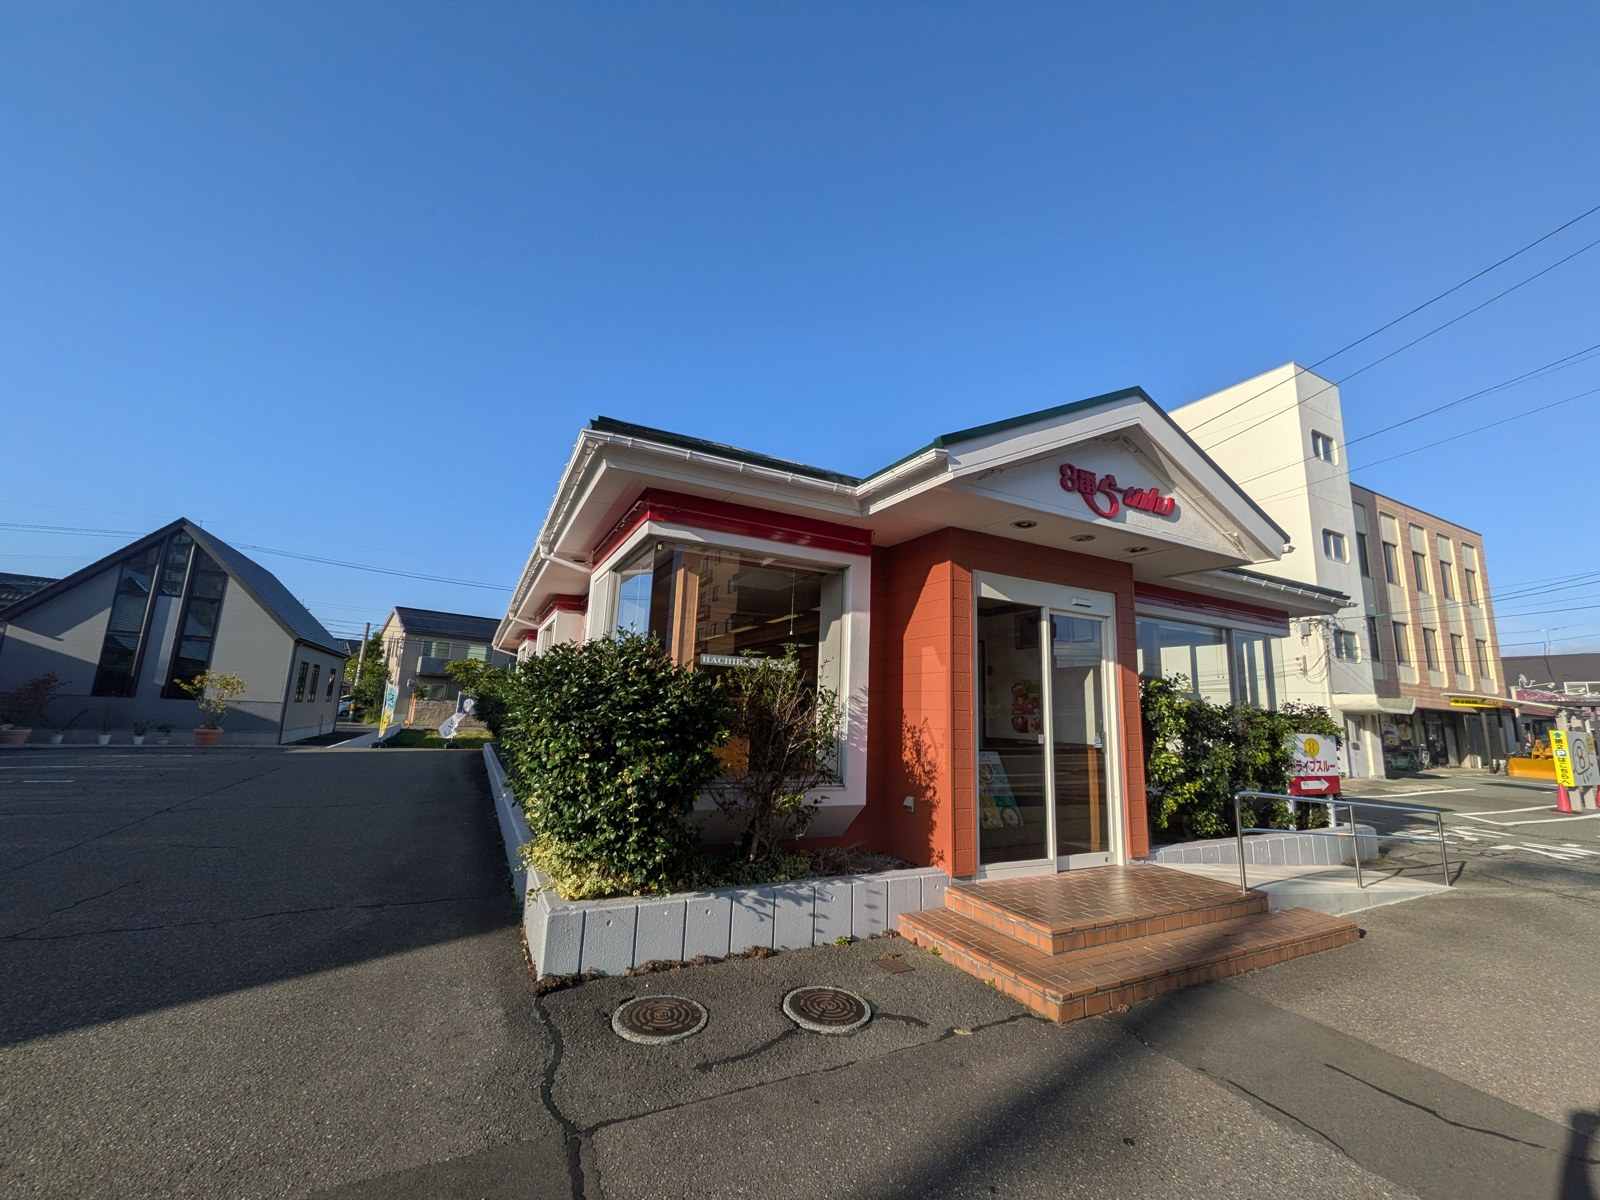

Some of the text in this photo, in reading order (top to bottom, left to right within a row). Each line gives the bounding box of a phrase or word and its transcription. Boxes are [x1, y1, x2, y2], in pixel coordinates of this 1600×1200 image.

[1291, 759, 1336, 773] ライブスルー
